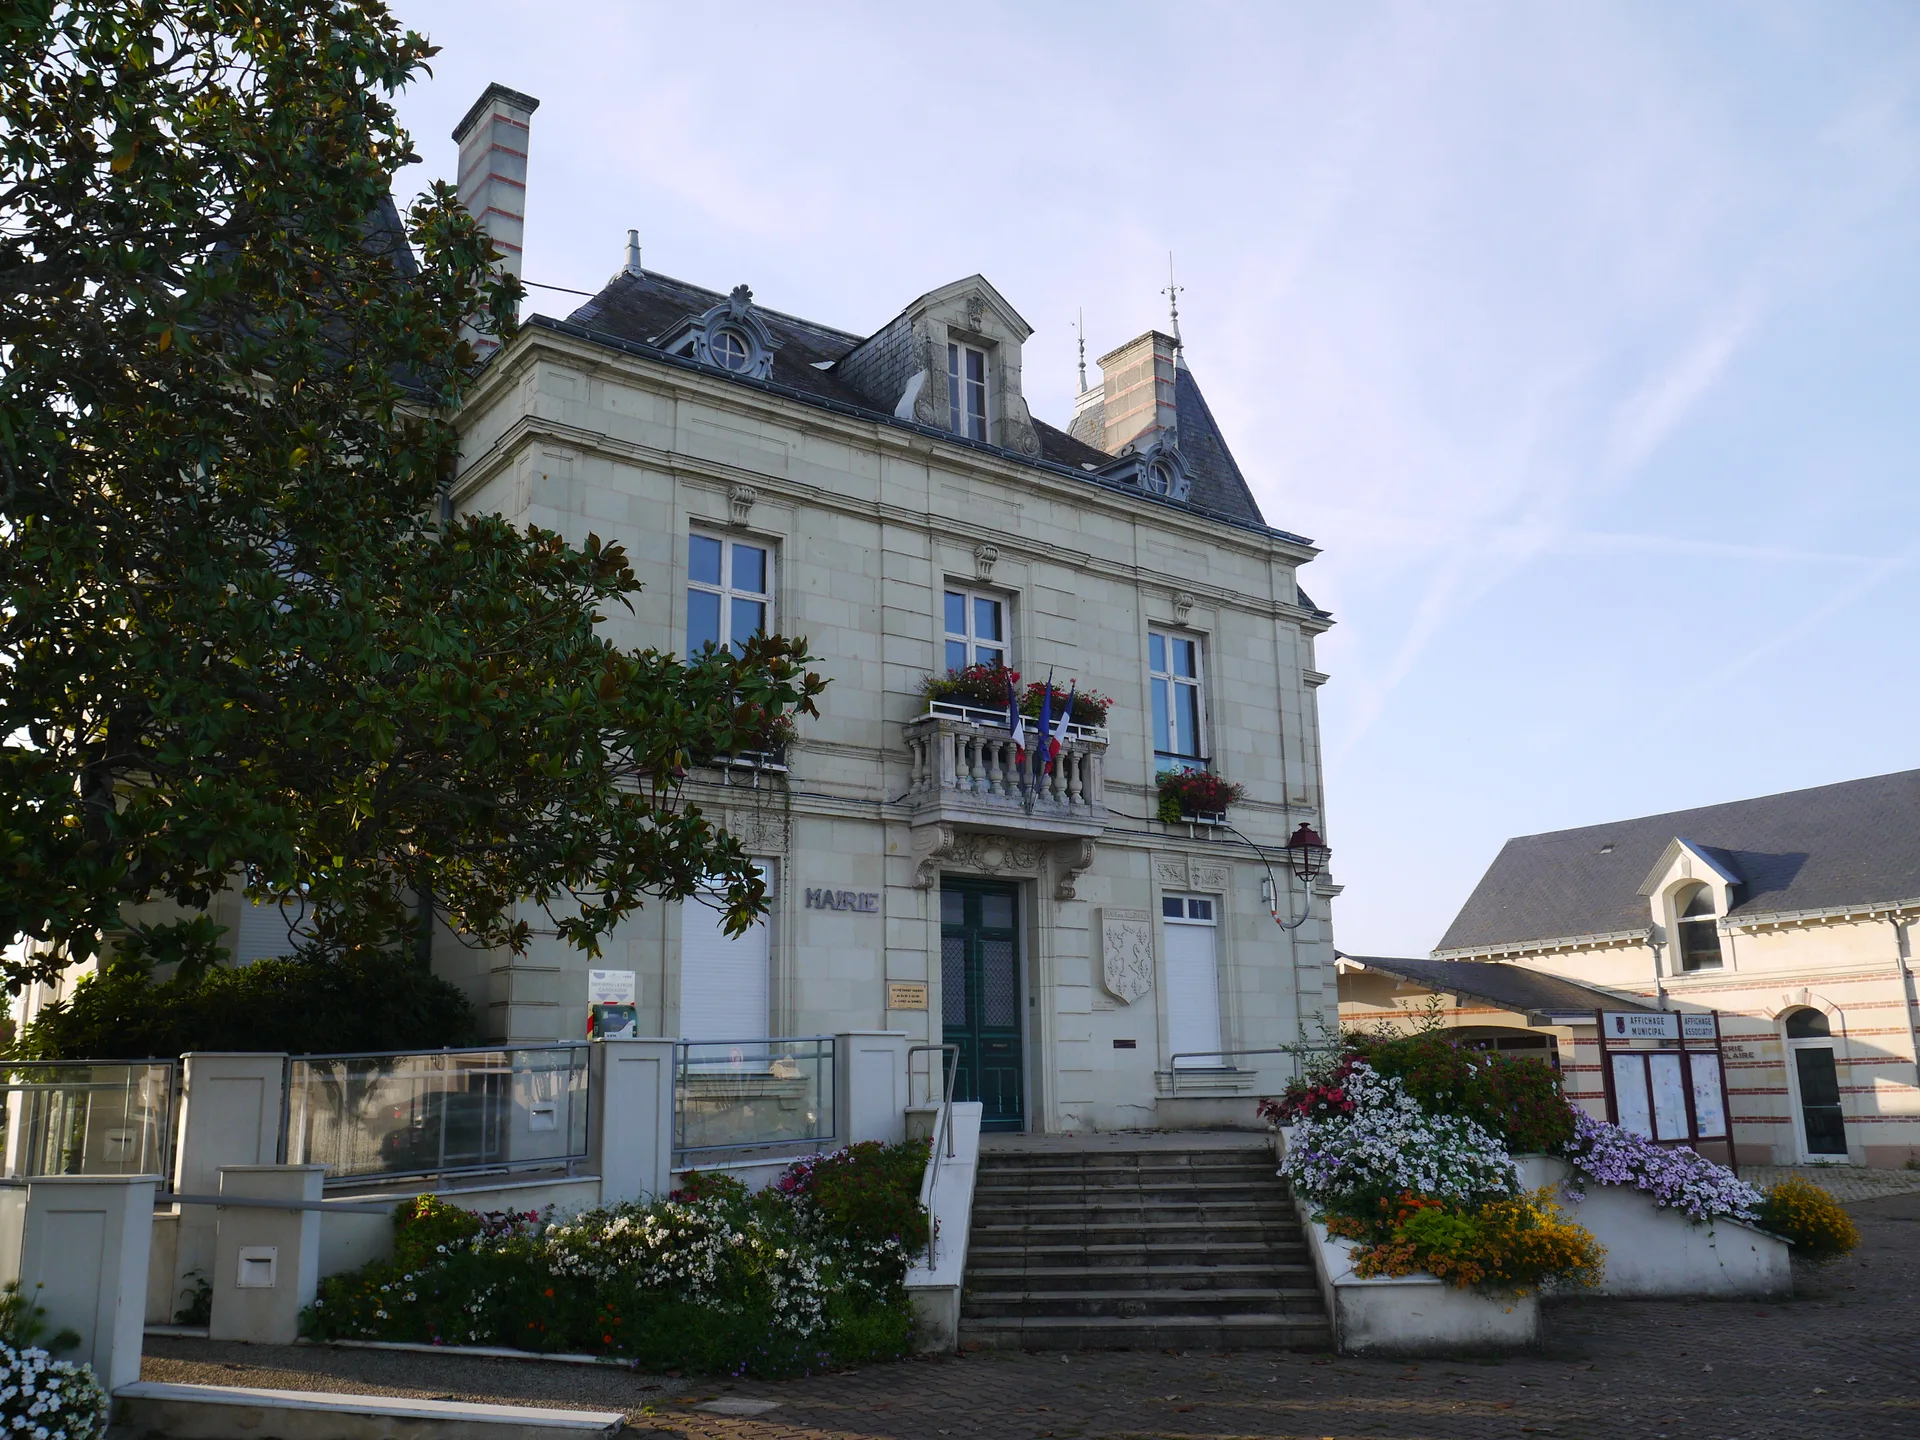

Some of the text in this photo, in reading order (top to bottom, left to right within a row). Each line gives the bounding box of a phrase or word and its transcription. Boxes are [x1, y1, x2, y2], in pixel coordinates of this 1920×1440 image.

[805, 888, 879, 913] MAIRIE
[1630, 1016, 1665, 1026] AFFICHAGE
[1684, 1017, 1712, 1026] AFFICHAGE
[1631, 1027, 1666, 1036] MUNICIPAL
[1685, 1028, 1713, 1036] ASSOCIATIF
